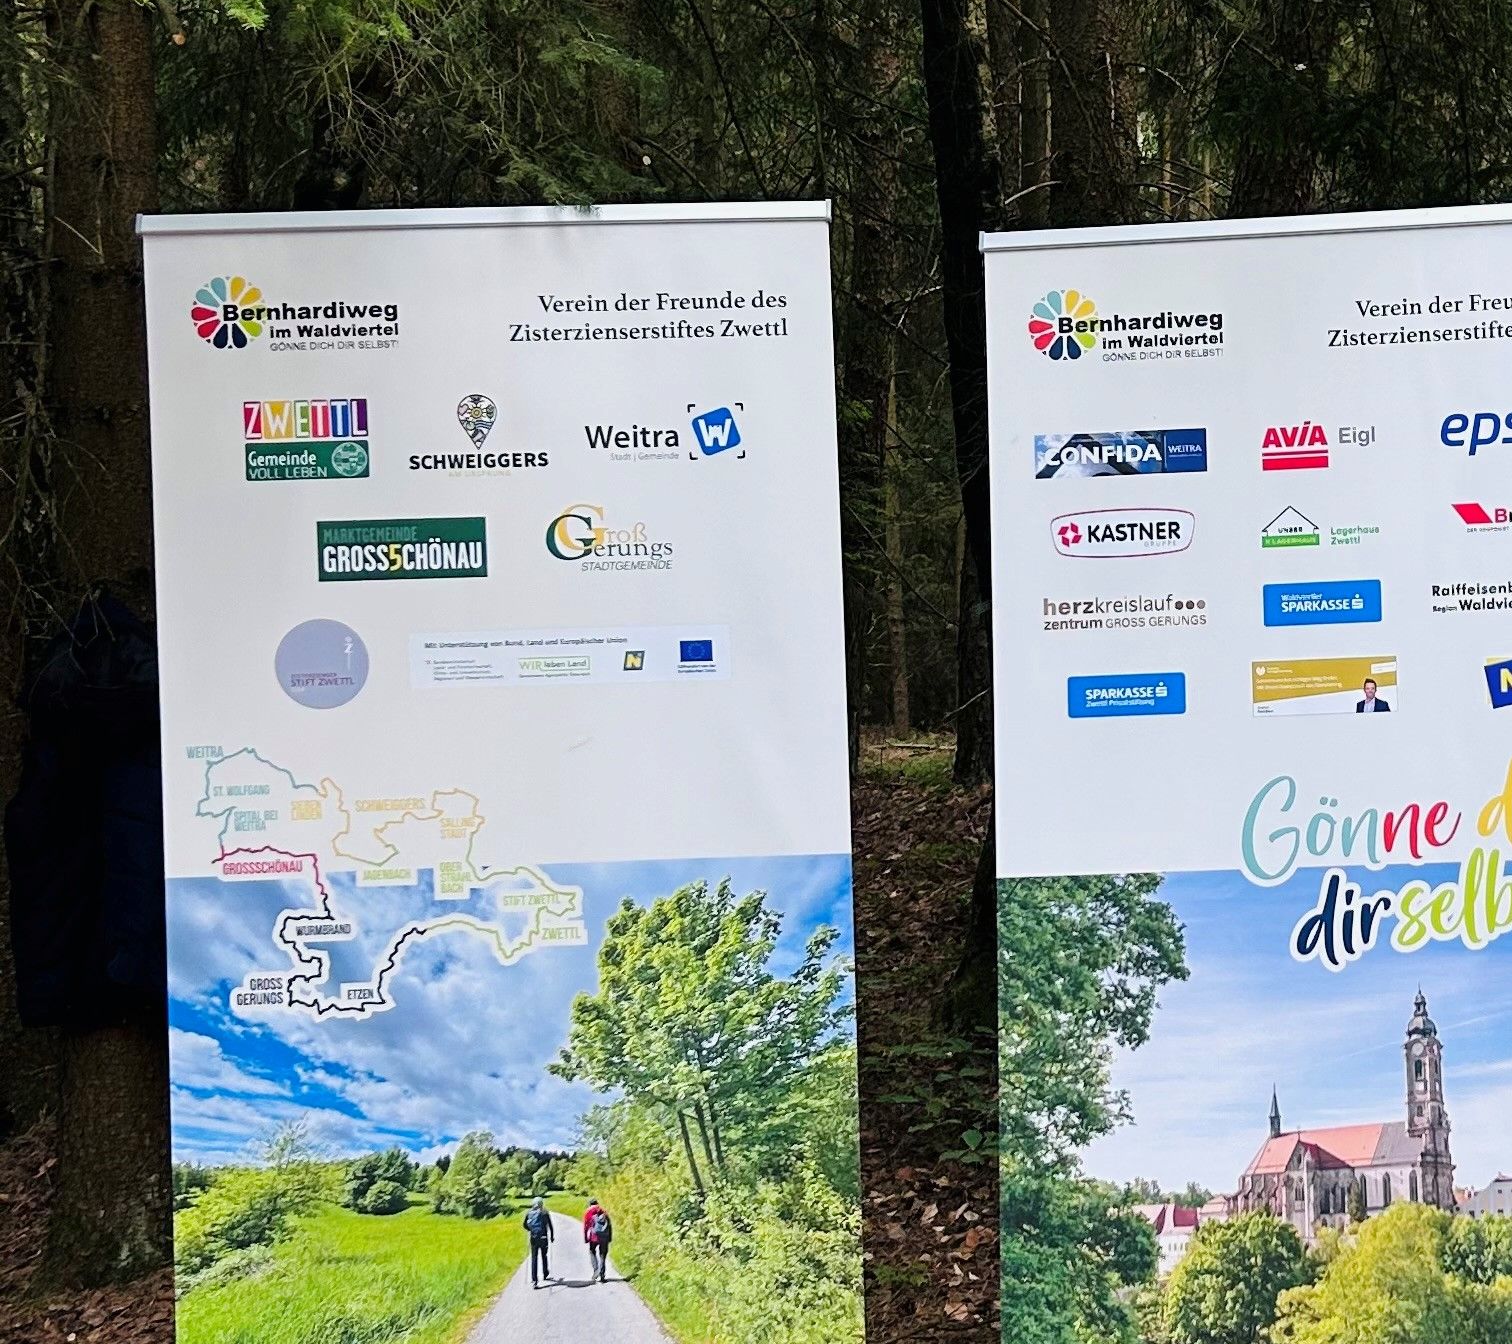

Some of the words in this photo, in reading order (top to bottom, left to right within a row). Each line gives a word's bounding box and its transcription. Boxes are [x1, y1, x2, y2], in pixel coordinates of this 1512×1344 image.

[538, 295, 608, 313] Verein
[615, 293, 650, 311] der
[656, 291, 745, 310] Freunde
[751, 290, 787, 307] des
[1355, 298, 1422, 317] Verein
[1428, 296, 1463, 314] der
[223, 302, 398, 321] Bernhardiweg
[270, 325, 291, 338] im
[297, 323, 399, 338] Waldviertel
[509, 320, 714, 341] Zisterzienserstiftes
[720, 318, 788, 337] Zwettl
[1058, 312, 1222, 334] Bernhardiweg
[309, 341, 334, 350] DICH
[337, 340, 355, 350] DIR
[1102, 337, 1122, 349] im
[1128, 332, 1224, 348] Waldviertel
[1140, 350, 1163, 360] DICH
[1166, 349, 1182, 359] DIR
[244, 400, 367, 439] ZWETTL
[585, 424, 679, 449] Weitra
[1338, 426, 1376, 447] Eigl
[248, 450, 316, 467] Gemeinde
[409, 452, 548, 470] SCHWEIGGERS
[1044, 444, 1162, 466] CONFIDA
[1168, 444, 1202, 453] WEITRA
[248, 467, 282, 479] VOLL
[286, 466, 327, 478] LEBEN
[323, 525, 417, 543] MARKTGEMEINDE
[1087, 522, 1181, 543] KASTNER
[582, 560, 673, 572] STADTGEMEINDE
[1043, 594, 1173, 615] herzkreislauf
[1281, 599, 1350, 612] SPARKASSE
[1044, 618, 1103, 631] zentrum
[1105, 618, 1145, 628] GROSS
[1149, 615, 1207, 627] GERUNGS
[1086, 686, 1154, 700] SPARKASSE
[186, 746, 223, 758] WEITRA
[1241, 775, 1462, 879] Gönne
[1297, 874, 1391, 966] dir
[250, 978, 283, 990] GROSS
[237, 991, 283, 1005] GERUNGS
[348, 989, 373, 1000] ETZEN
